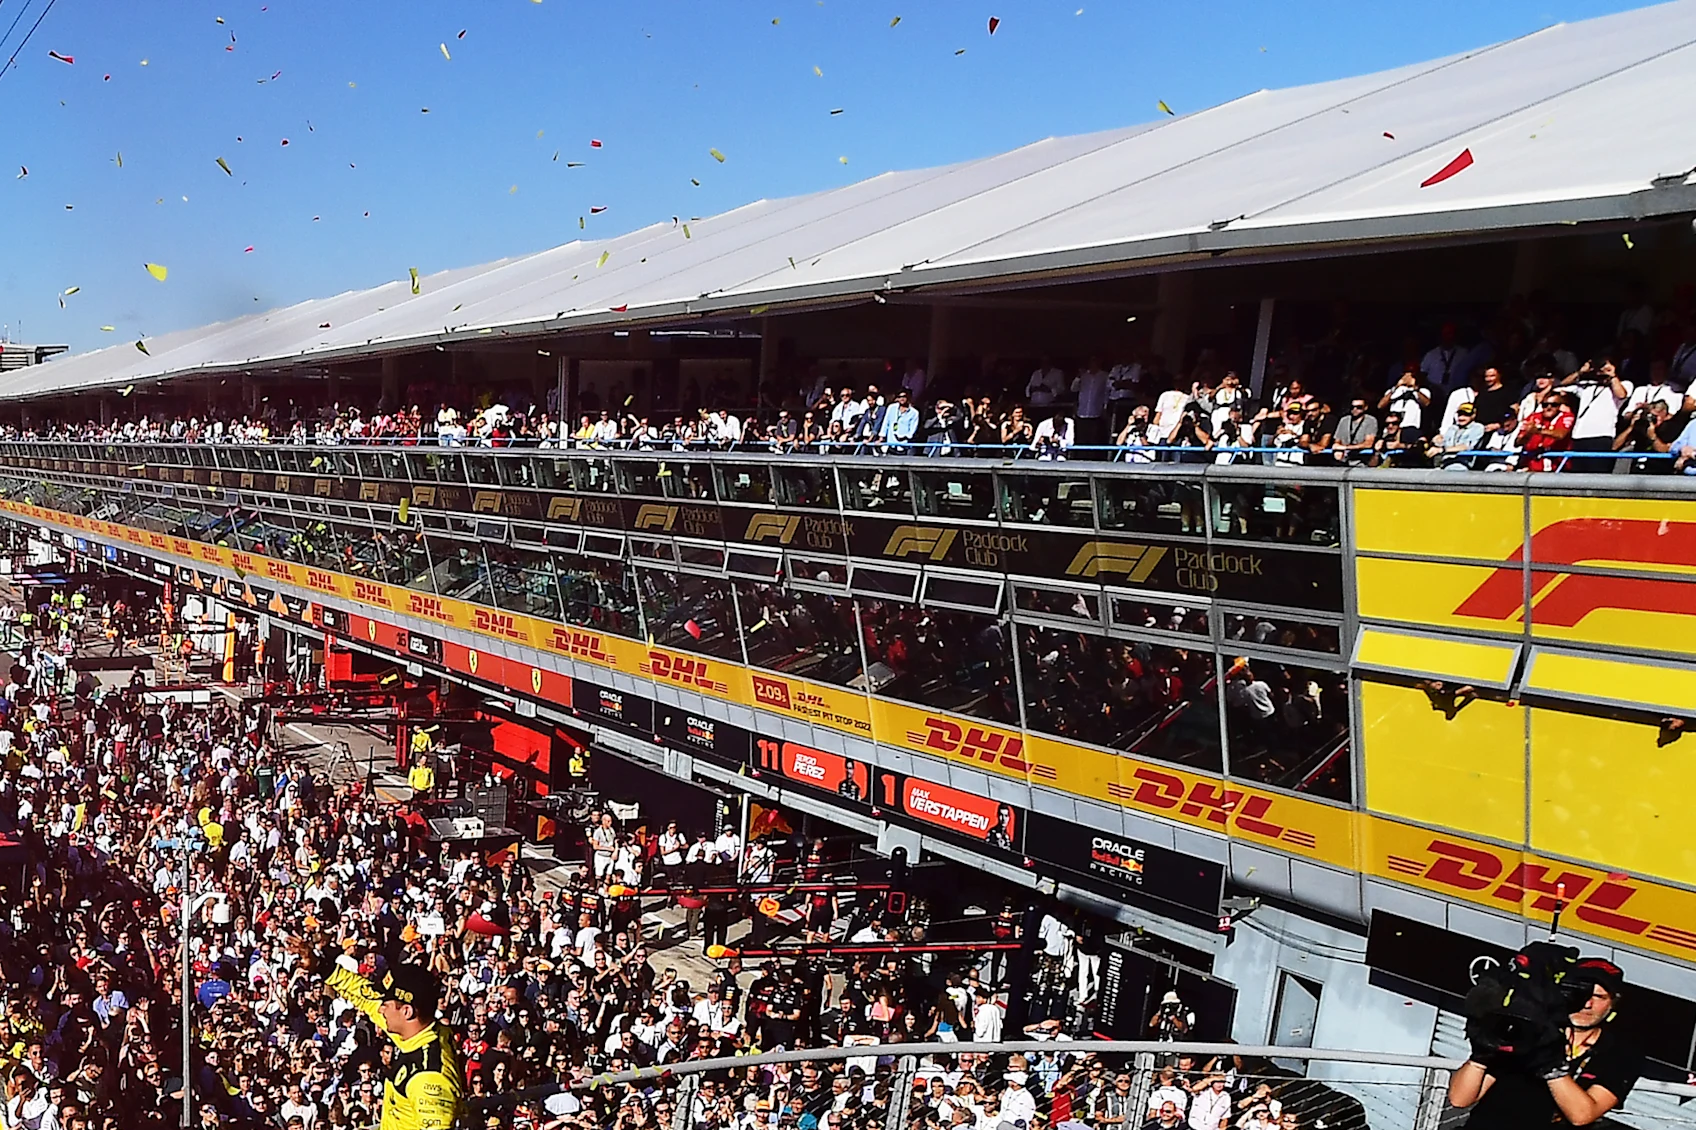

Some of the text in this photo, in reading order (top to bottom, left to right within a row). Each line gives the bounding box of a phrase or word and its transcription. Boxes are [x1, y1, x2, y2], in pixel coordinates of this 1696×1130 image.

[473, 491, 503, 513] F1
[546, 496, 581, 521] F1
[633, 503, 720, 531] F1 Paddock
[683, 518, 706, 536] Club
[744, 512, 855, 545] F1 Paddock
[806, 530, 834, 550] Club
[883, 524, 1028, 561] F1 Paddock
[963, 546, 999, 568] Club
[1065, 541, 1263, 583] F1 Paddock
[307, 570, 337, 592] DHL
[354, 580, 389, 604] DHL
[1176, 567, 1219, 593] Club
[410, 594, 448, 620] DHL
[474, 609, 520, 638] DHL
[553, 628, 607, 661] DHL
[648, 651, 714, 691] DHL
[797, 691, 825, 707] DHL
[793, 703, 821, 718] FASTEST
[823, 711, 833, 721] PIT
[834, 714, 853, 726] STOP
[757, 738, 779, 771] 11
[925, 717, 1029, 771] DHL
[793, 761, 826, 780] PEREZ
[795, 752, 817, 767] SERGIO
[880, 773, 896, 807] 1
[911, 787, 931, 800] MAX
[1133, 767, 1283, 839] DHL
[909, 796, 989, 830] VERSTAPPEN
[1091, 836, 1145, 862] ORACLE
[1089, 862, 1144, 886] RACING
[1424, 839, 1652, 935] DHL
